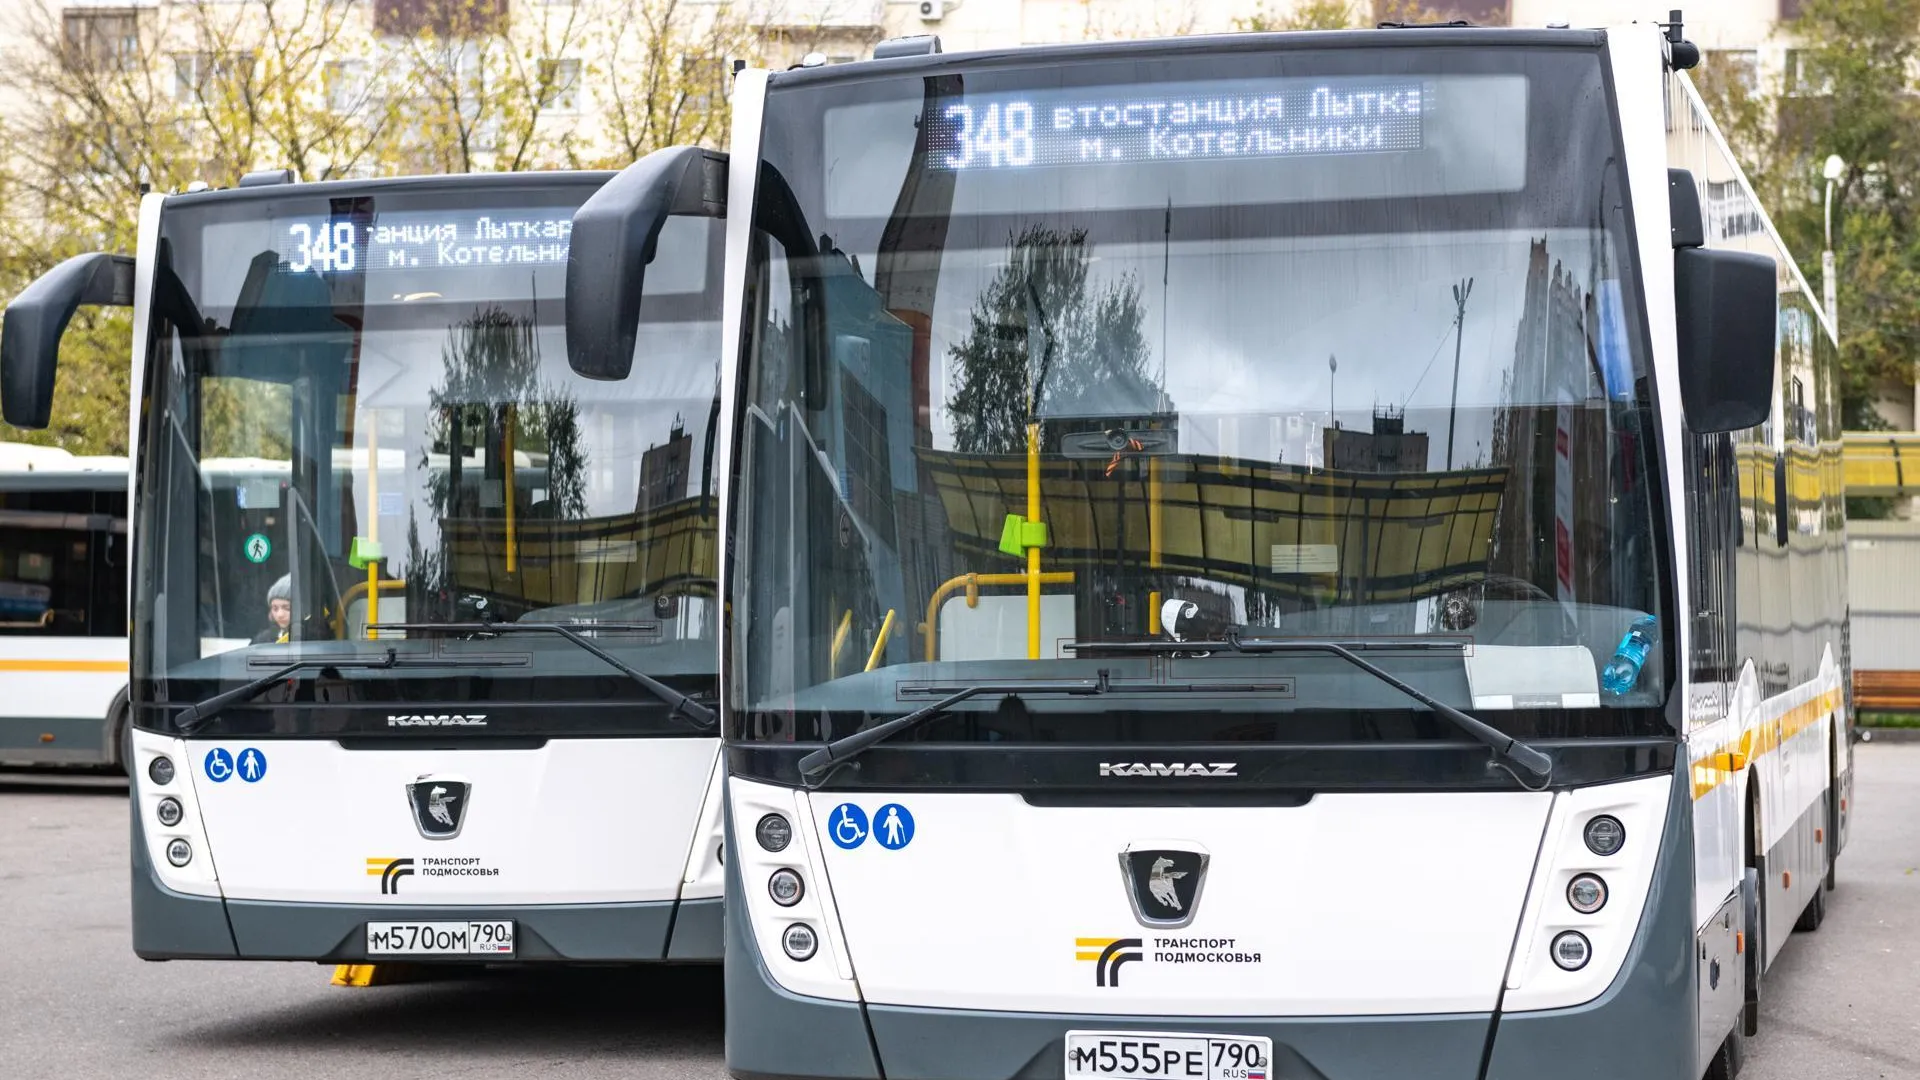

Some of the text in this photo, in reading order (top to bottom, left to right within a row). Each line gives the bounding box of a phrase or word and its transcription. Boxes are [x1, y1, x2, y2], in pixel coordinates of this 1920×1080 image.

[1054, 97, 1282, 129] втостанция
[946, 102, 1033, 168] 348
[1081, 125, 1382, 159] м. Котельники
[366, 217, 573, 245] анция Лыткар
[289, 222, 355, 272] 348
[388, 249, 418, 266] м.
[388, 714, 487, 726] KAMAZ
[1100, 762, 1238, 776] KAMAZ
[422, 858, 481, 866] ТРАНСПОРТ
[422, 868, 499, 877] ПОДМОСКОВЬЯ
[471, 924, 506, 943] 790
[479, 943, 498, 951] RUS
[1154, 938, 1236, 949] ТРАНСПОРТ
[1154, 953, 1262, 963] ПОДМОСКОВЬЯ
[1211, 1043, 1260, 1068] 790
[1223, 1069, 1247, 1079] RUS
